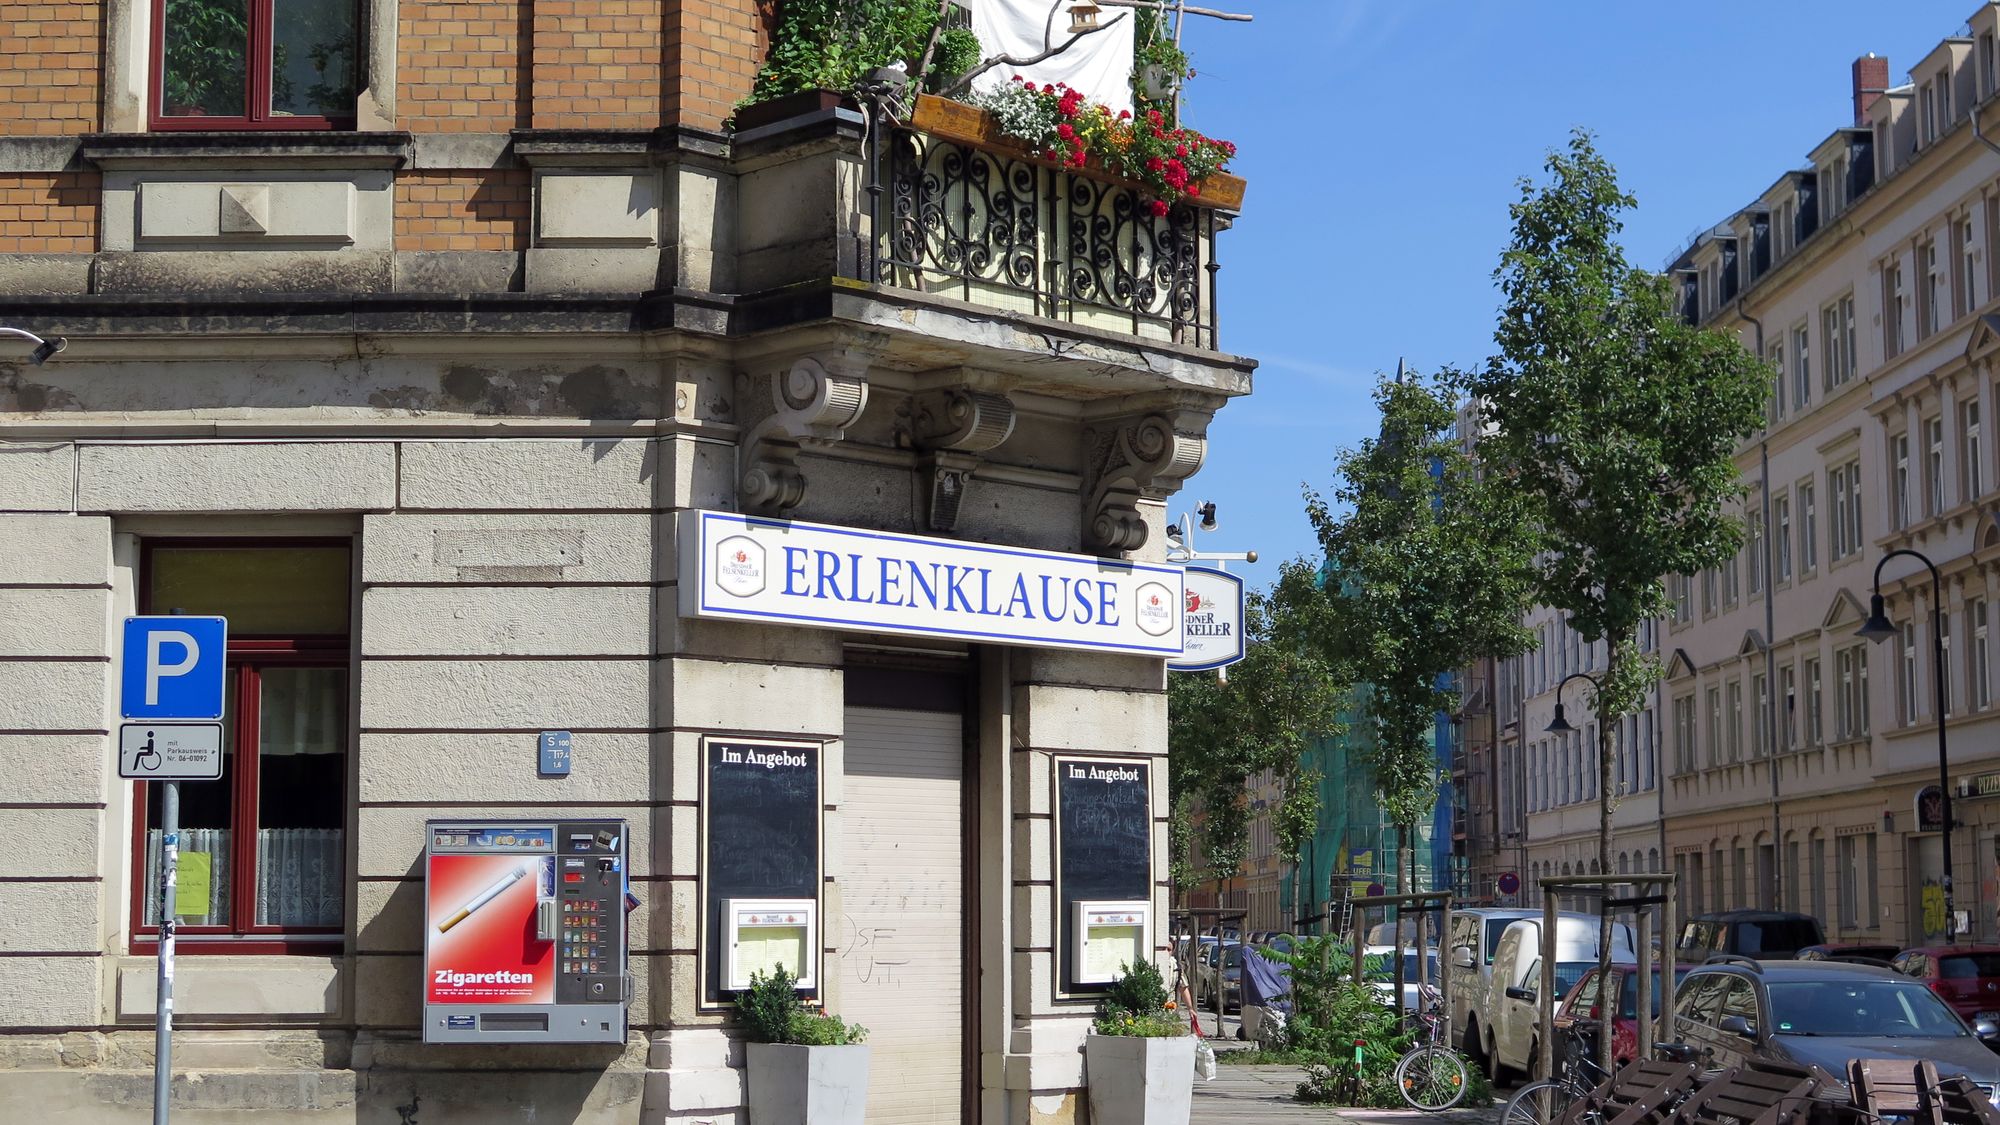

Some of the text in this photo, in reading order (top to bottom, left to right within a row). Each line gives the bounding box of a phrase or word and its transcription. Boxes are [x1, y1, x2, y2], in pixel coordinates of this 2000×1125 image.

[781, 545, 1120, 628] ERLENKLAUSE
[145, 630, 200, 706] P
[167, 747, 208, 755] Parkausweis
[547, 737, 555, 746] S
[721, 747, 808, 770] Im Angebot
[1068, 764, 1140, 784] Im Angebot
[435, 969, 533, 987] Zigaretten
